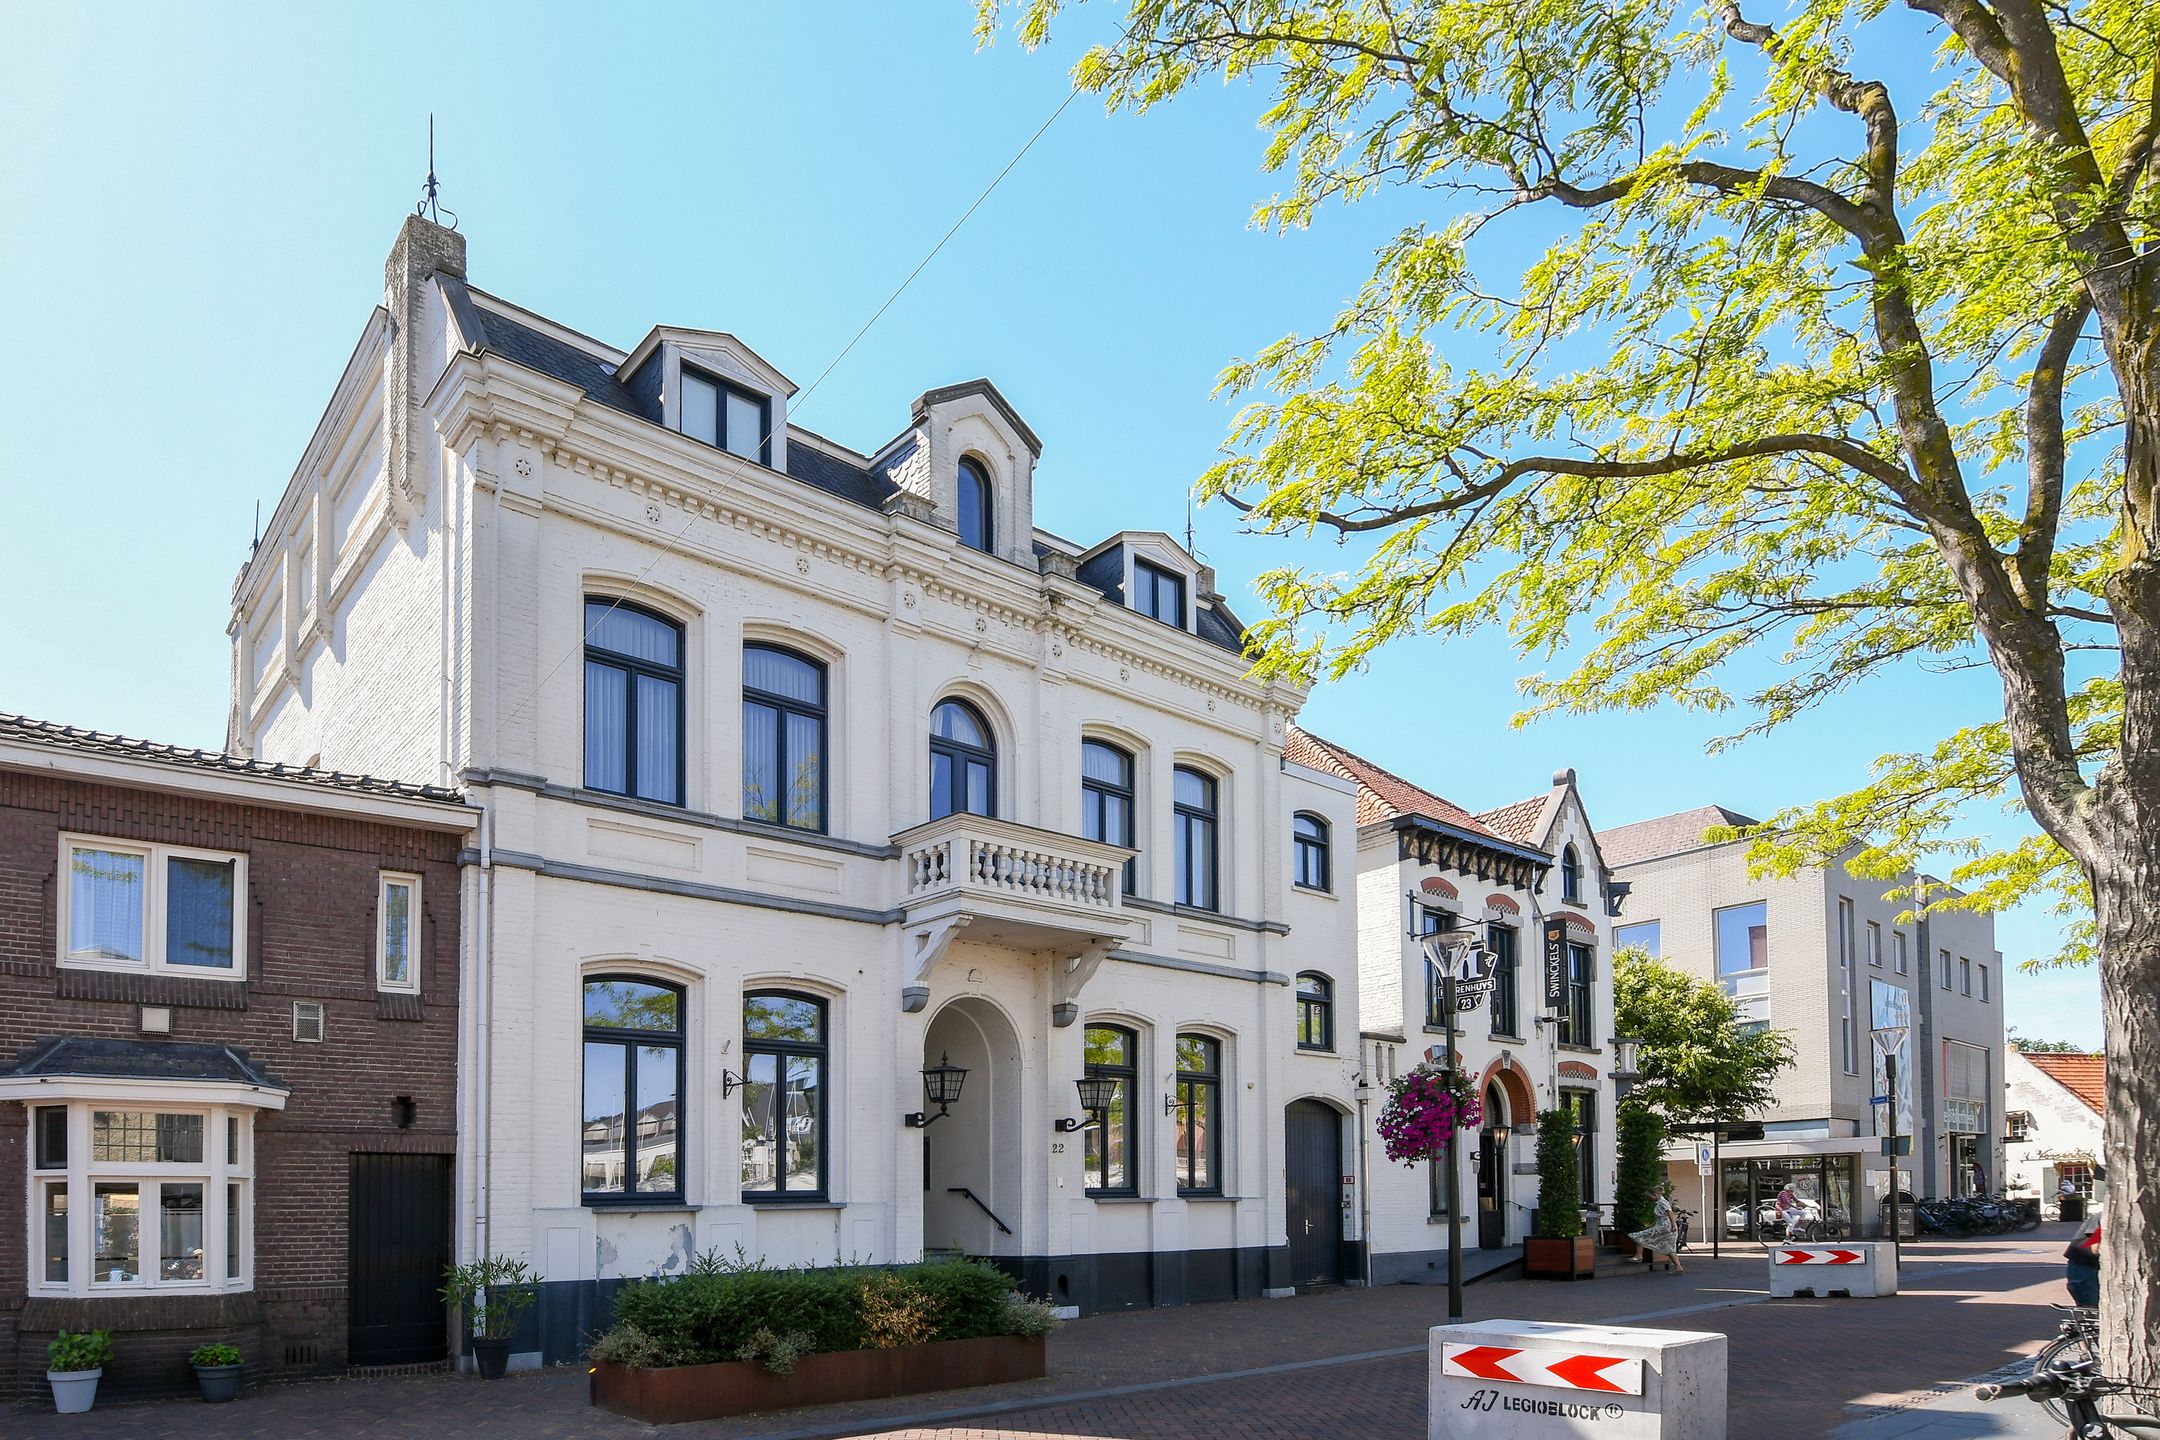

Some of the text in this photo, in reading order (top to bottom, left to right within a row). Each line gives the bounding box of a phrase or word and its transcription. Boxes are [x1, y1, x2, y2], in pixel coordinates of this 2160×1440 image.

[1460, 998, 1472, 1010] 23
[1052, 1143, 1065, 1154] 22
[1460, 1389, 1500, 1412] AJ
[1503, 1396, 1601, 1421] LEGIOBLOCK
